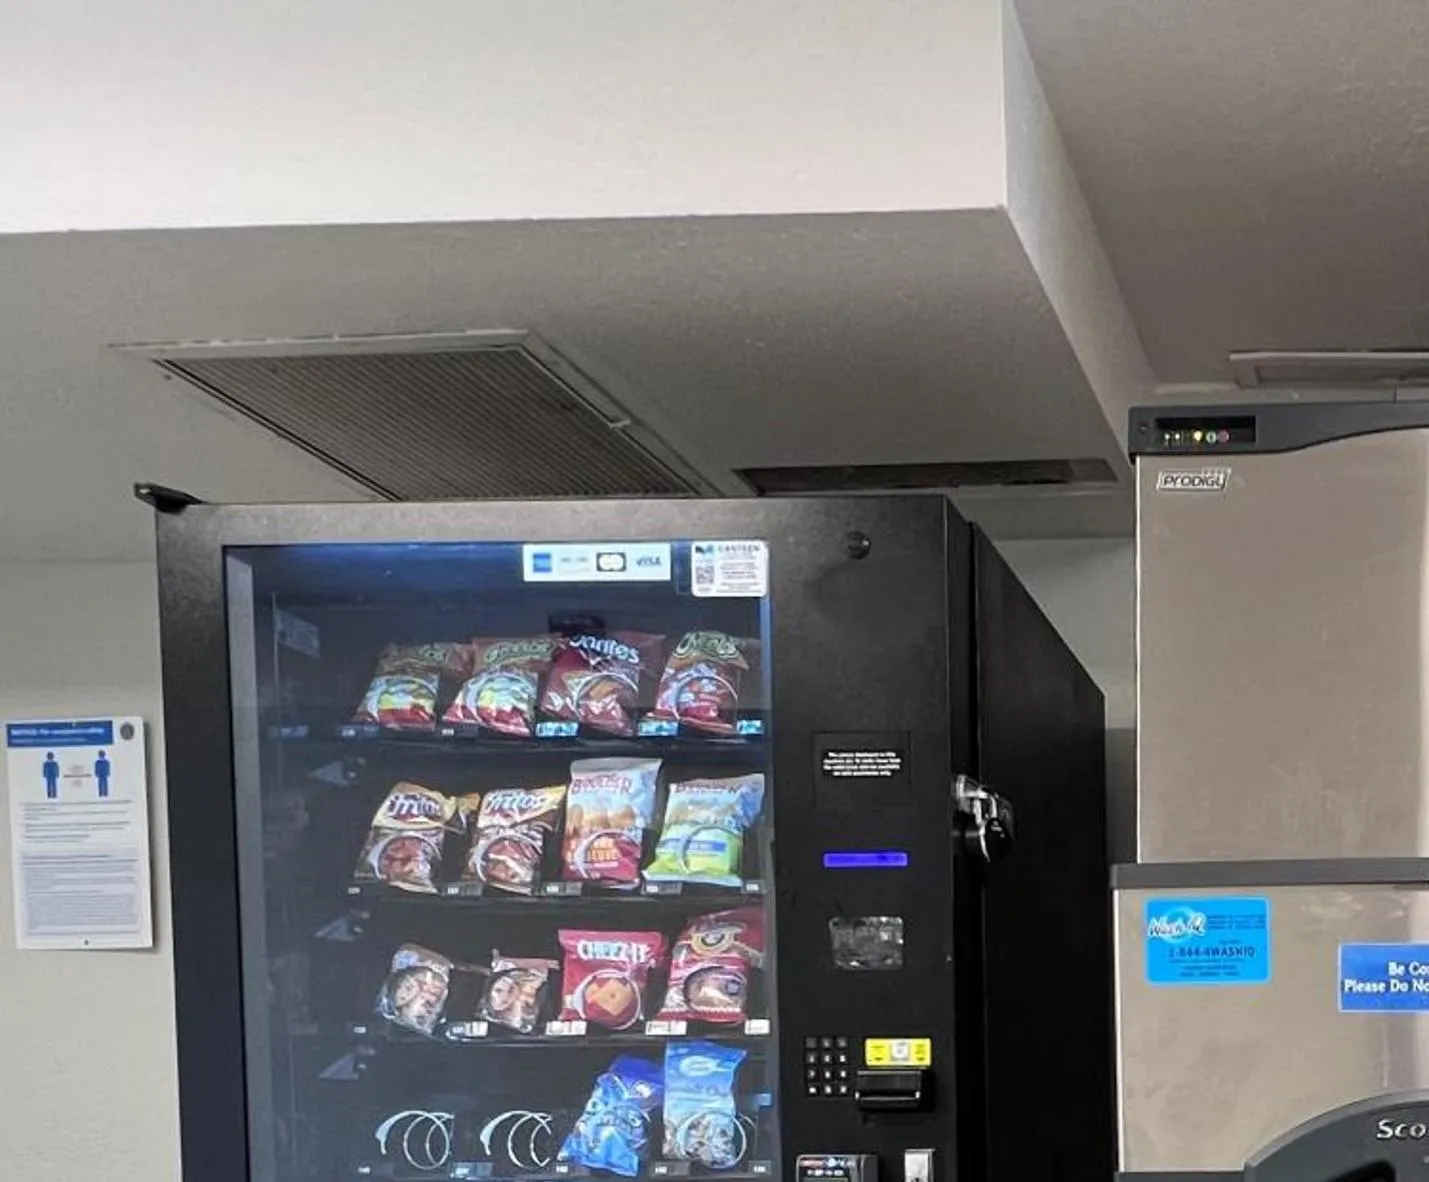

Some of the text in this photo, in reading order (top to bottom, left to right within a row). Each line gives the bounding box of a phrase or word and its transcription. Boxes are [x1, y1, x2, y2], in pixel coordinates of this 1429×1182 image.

[1388, 962, 1404, 976] Be
[1344, 979, 1386, 993] Please
[1390, 979, 1408, 993] Do
